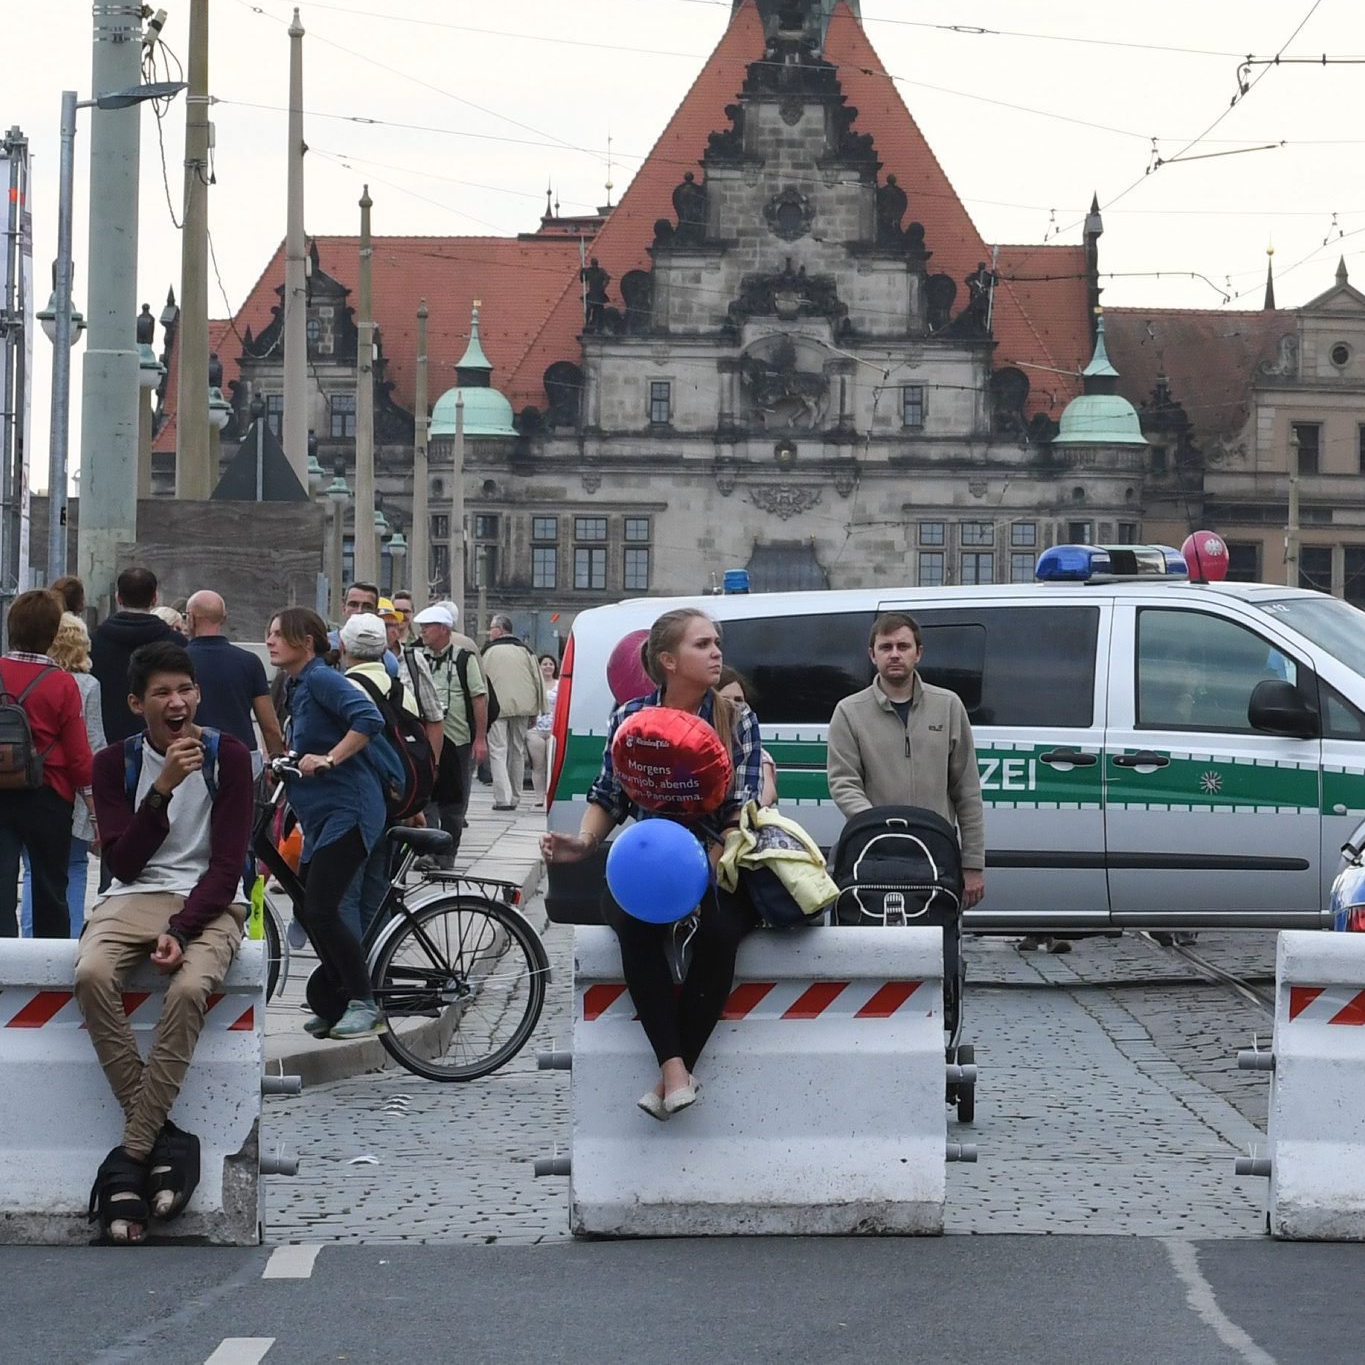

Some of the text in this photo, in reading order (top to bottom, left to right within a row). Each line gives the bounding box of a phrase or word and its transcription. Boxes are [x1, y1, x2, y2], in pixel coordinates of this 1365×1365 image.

[628, 759, 671, 776] Morgens
[977, 757, 1037, 791] ZEI
[660, 777, 700, 789] abends
